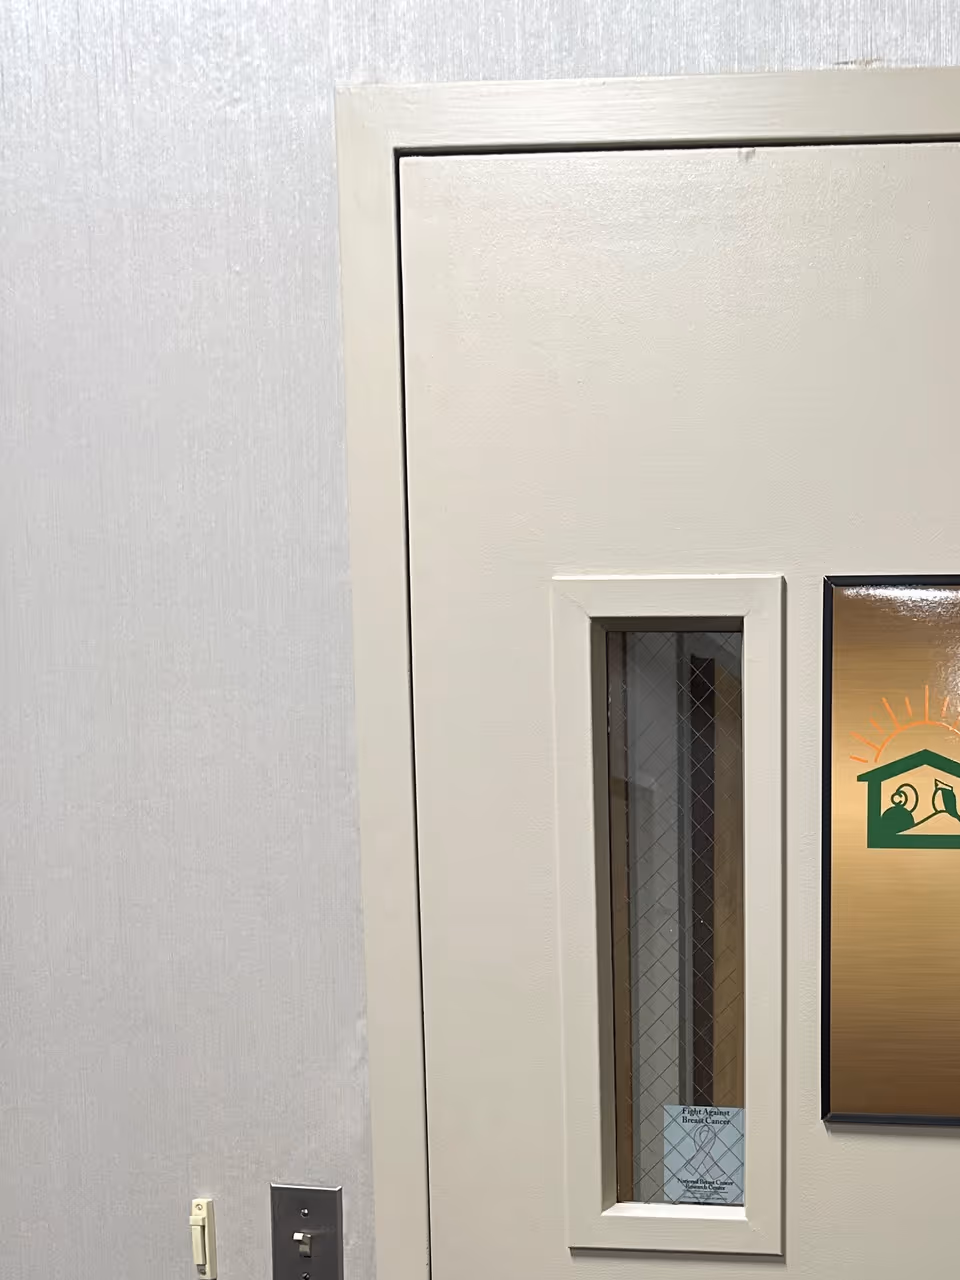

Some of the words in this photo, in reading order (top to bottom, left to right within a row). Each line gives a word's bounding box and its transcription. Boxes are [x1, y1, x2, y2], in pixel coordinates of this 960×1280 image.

[682, 1107, 702, 1116] Fight
[703, 1108, 730, 1116] Against
[682, 1116, 704, 1124] Breast
[705, 1117, 730, 1125] Cancer
